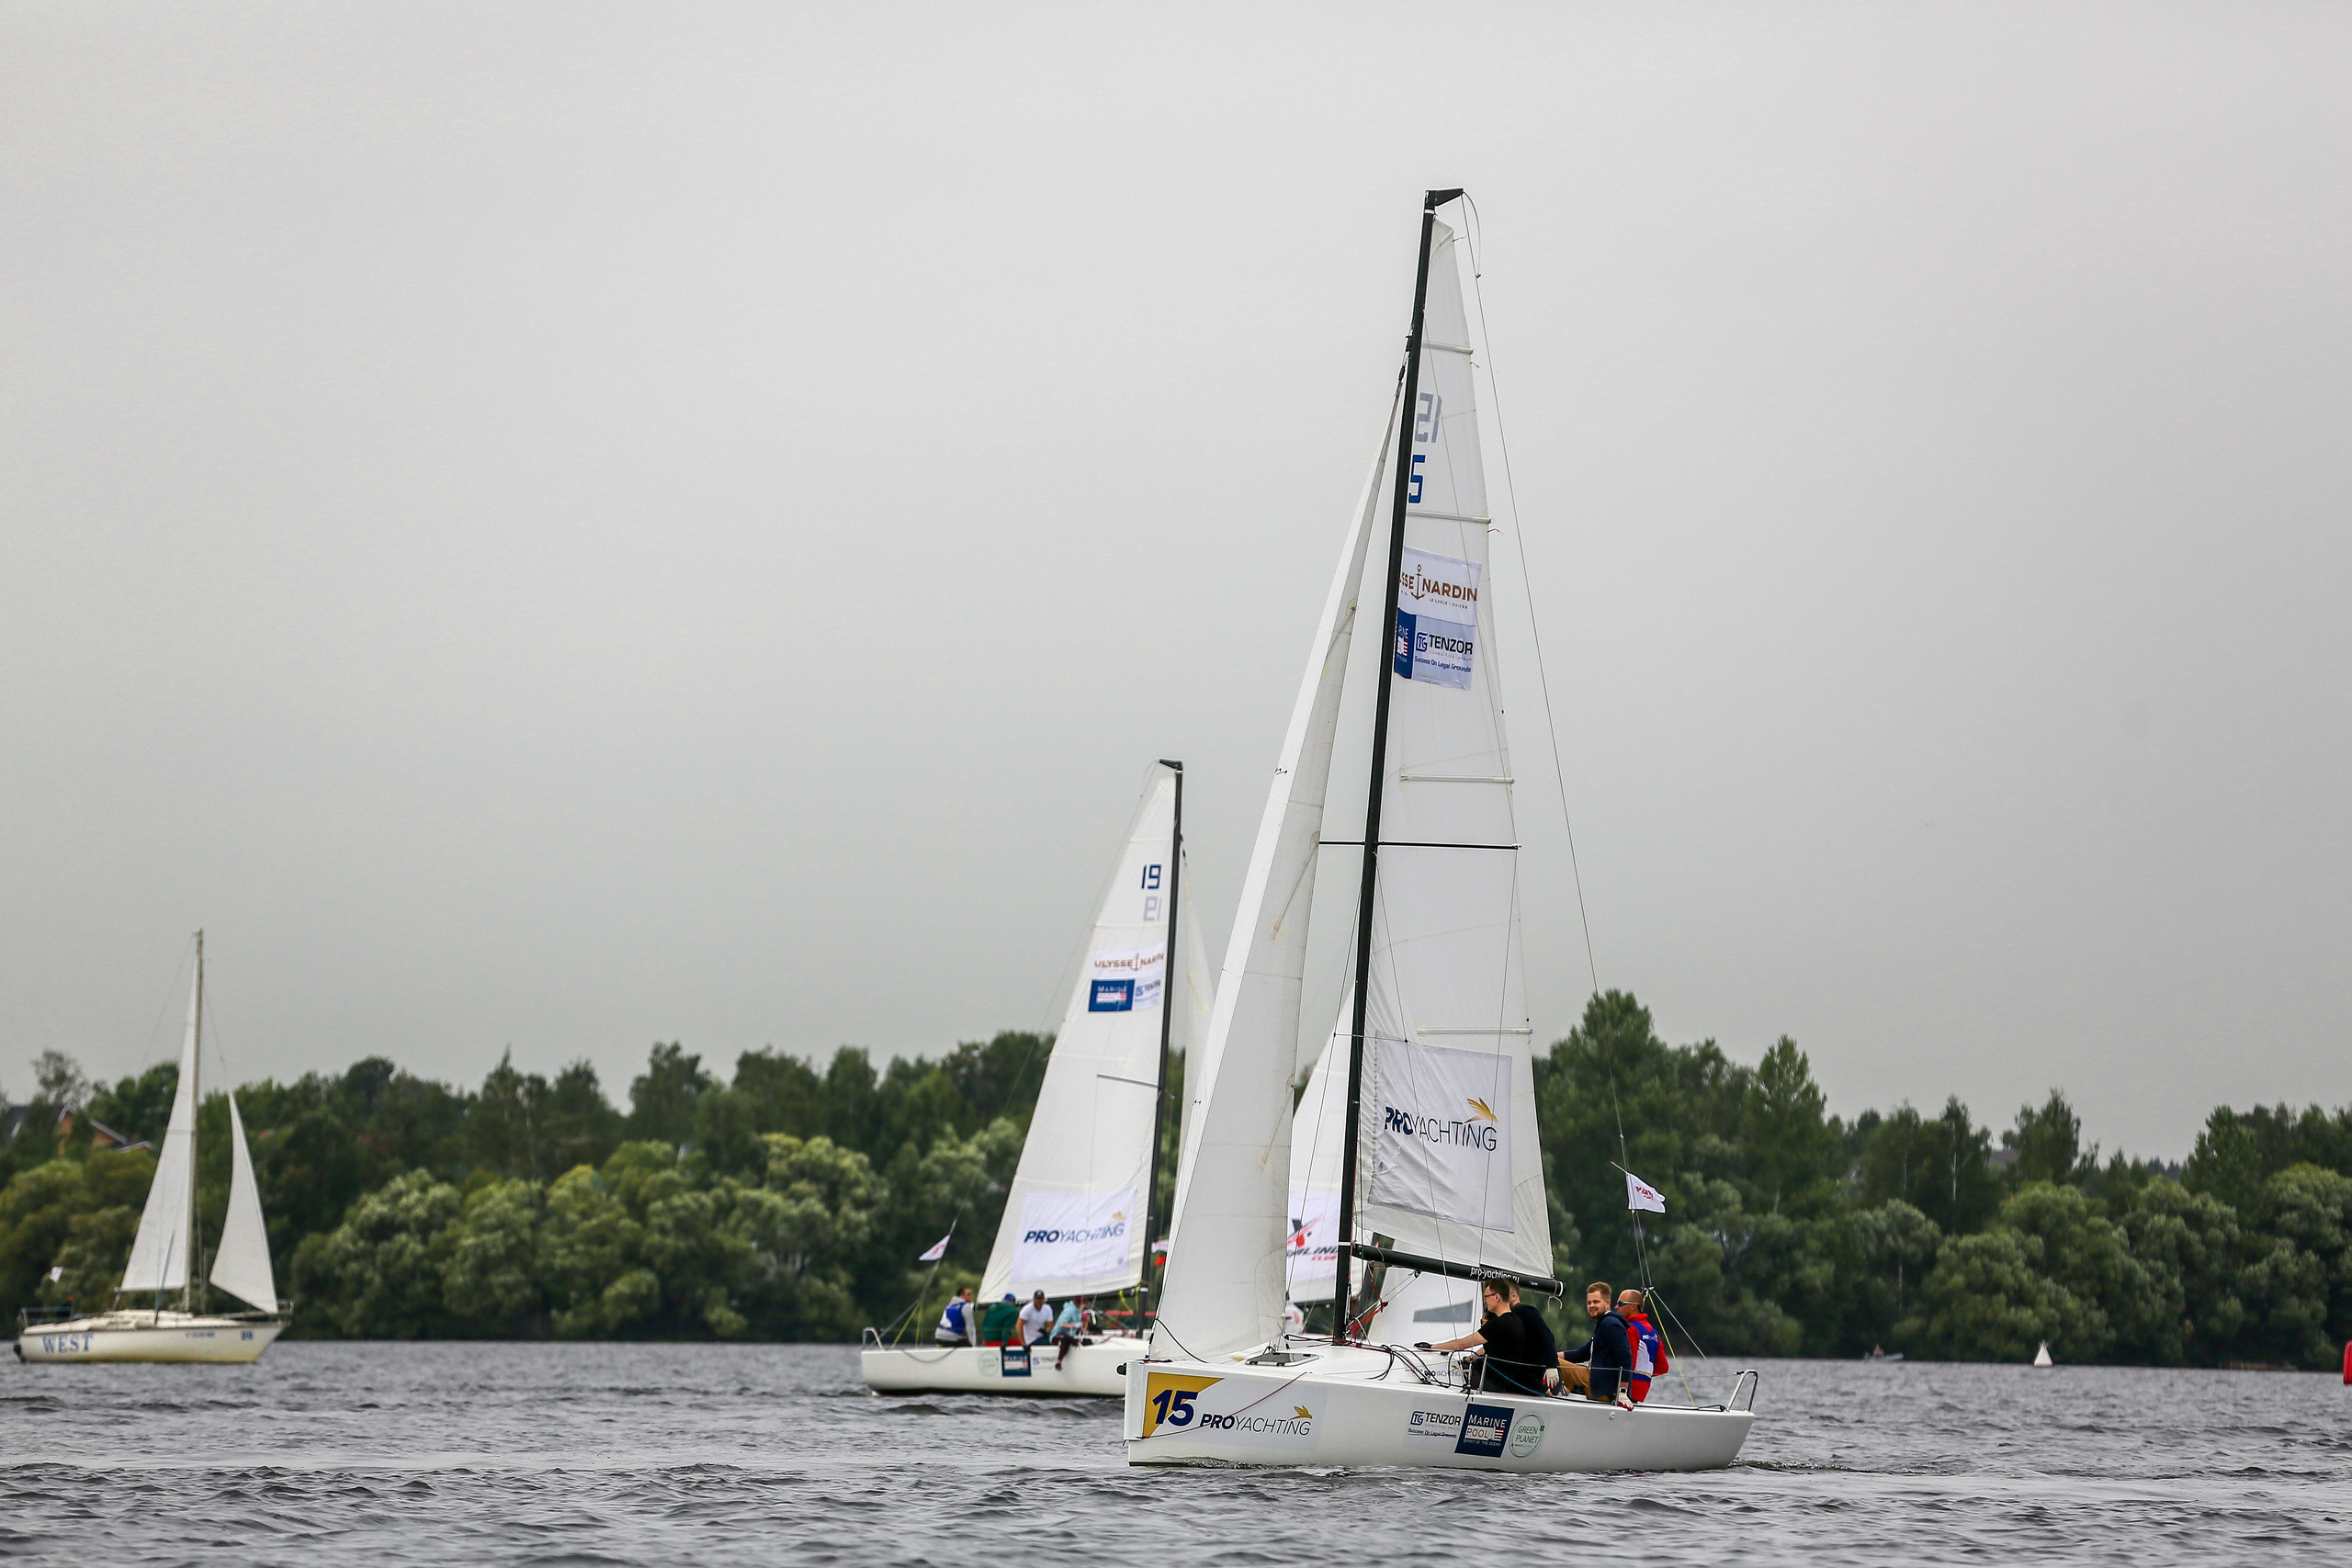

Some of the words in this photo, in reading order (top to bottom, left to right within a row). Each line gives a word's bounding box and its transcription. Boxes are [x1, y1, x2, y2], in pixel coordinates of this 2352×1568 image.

[1408, 454, 1426, 503] 5
[1400, 571, 1415, 590] SSE
[1422, 578, 1477, 602] NARDIN
[1429, 634, 1474, 655] TENZOR
[1415, 655, 1430, 665] Success
[1438, 660, 1450, 670] Legal
[1452, 663, 1471, 671] Grounds
[1141, 863, 1162, 889] 19
[1094, 959, 1134, 968] ULYSSE
[1384, 1106, 1498, 1152] PROYACHTING
[1023, 1222, 1125, 1244] PROYACHTING
[42, 1334, 94, 1353] WEST
[1152, 1389, 1199, 1427] 15
[1199, 1413, 1312, 1436] PROYACHTING
[1425, 1412, 1462, 1427] TENZOR
[1468, 1414, 1508, 1428] MARINE
[1467, 1427, 1488, 1438] POOL
[1516, 1434, 1539, 1444] PLANET
[1518, 1425, 1539, 1435] GREEN
